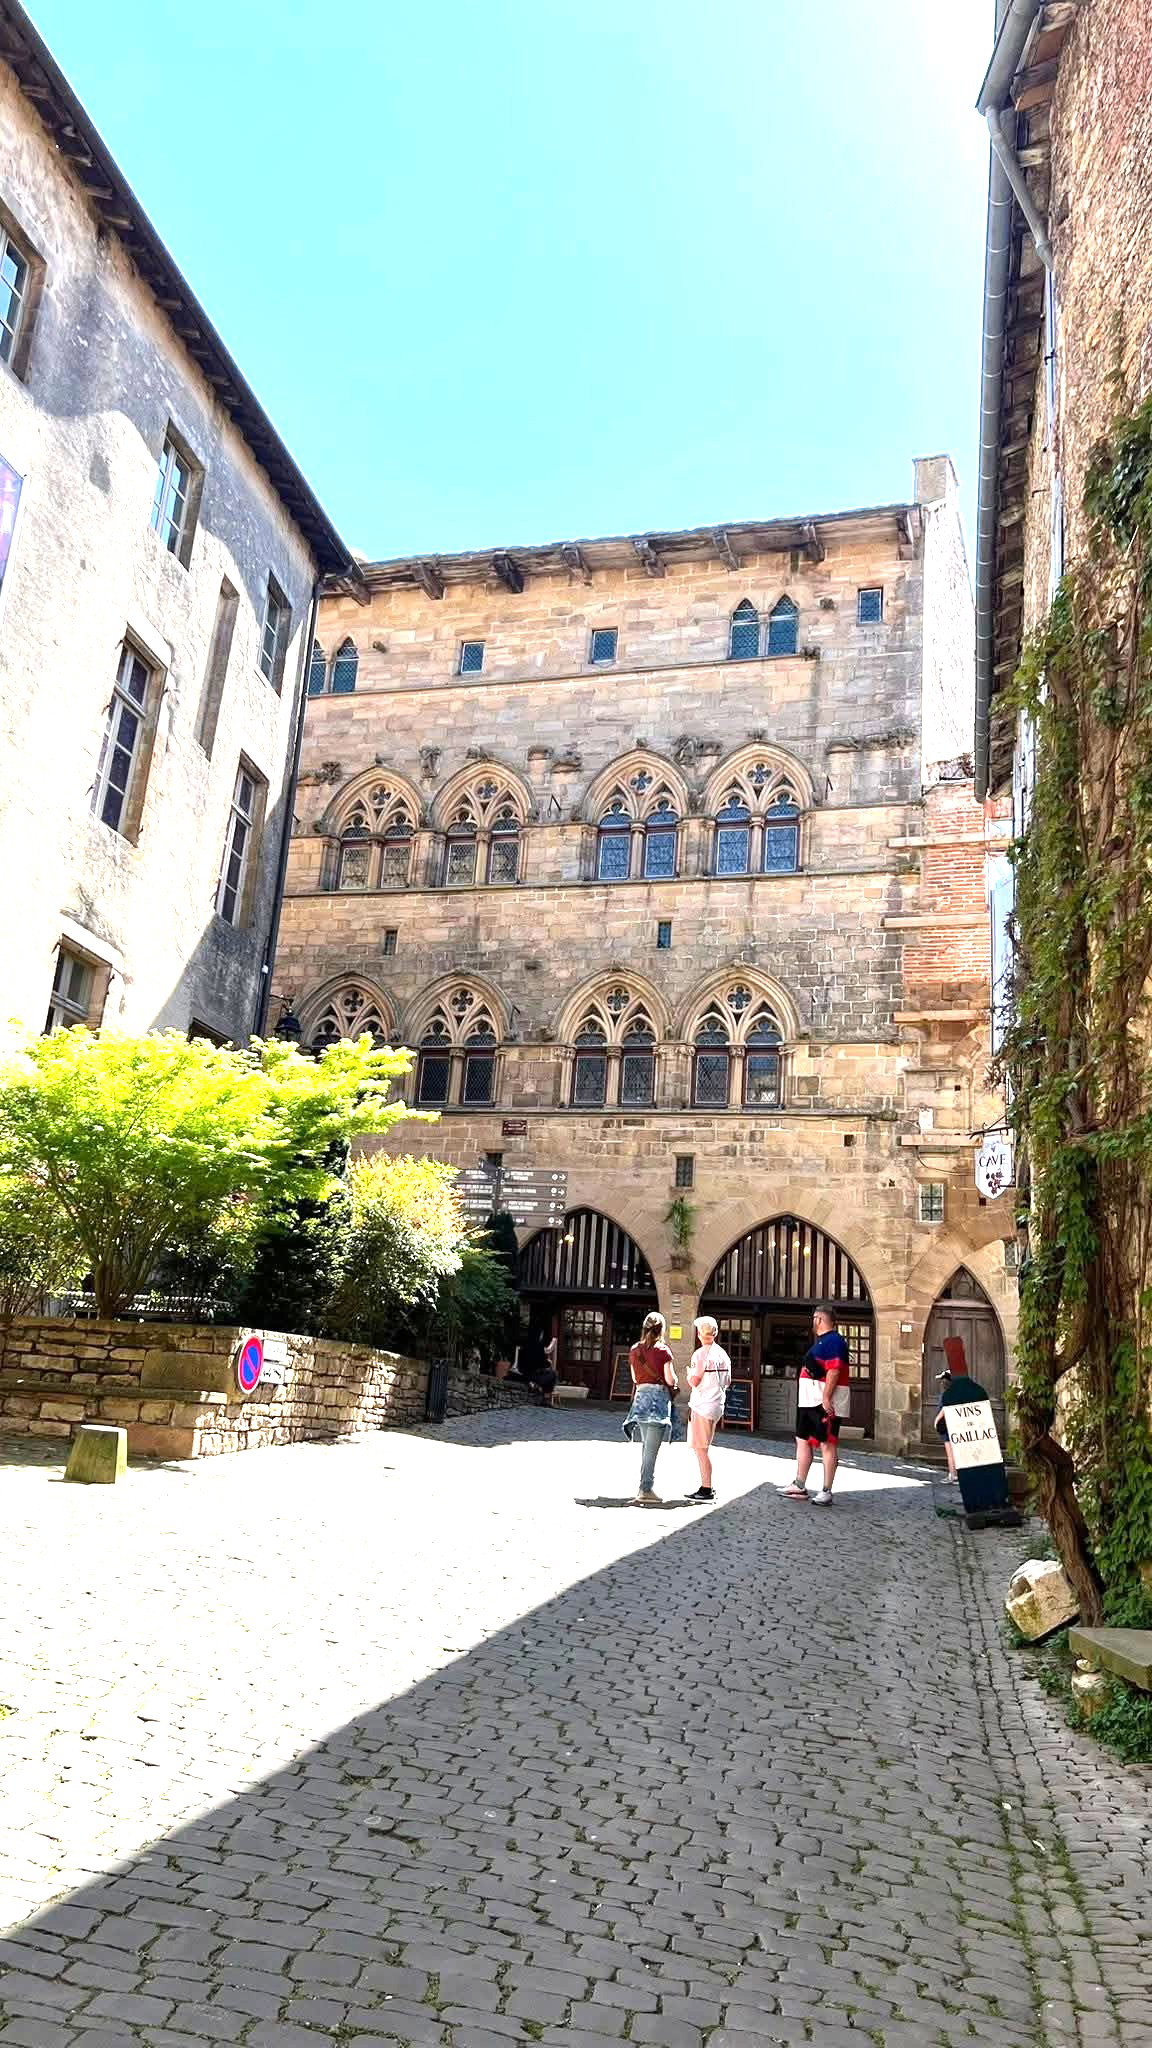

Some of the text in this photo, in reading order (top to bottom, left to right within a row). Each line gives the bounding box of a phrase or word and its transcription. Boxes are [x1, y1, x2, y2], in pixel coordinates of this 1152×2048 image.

[979, 1153, 1006, 1167] CAVE
[955, 1405, 982, 1417] VINS
[951, 1427, 997, 1444] GAILLAC
